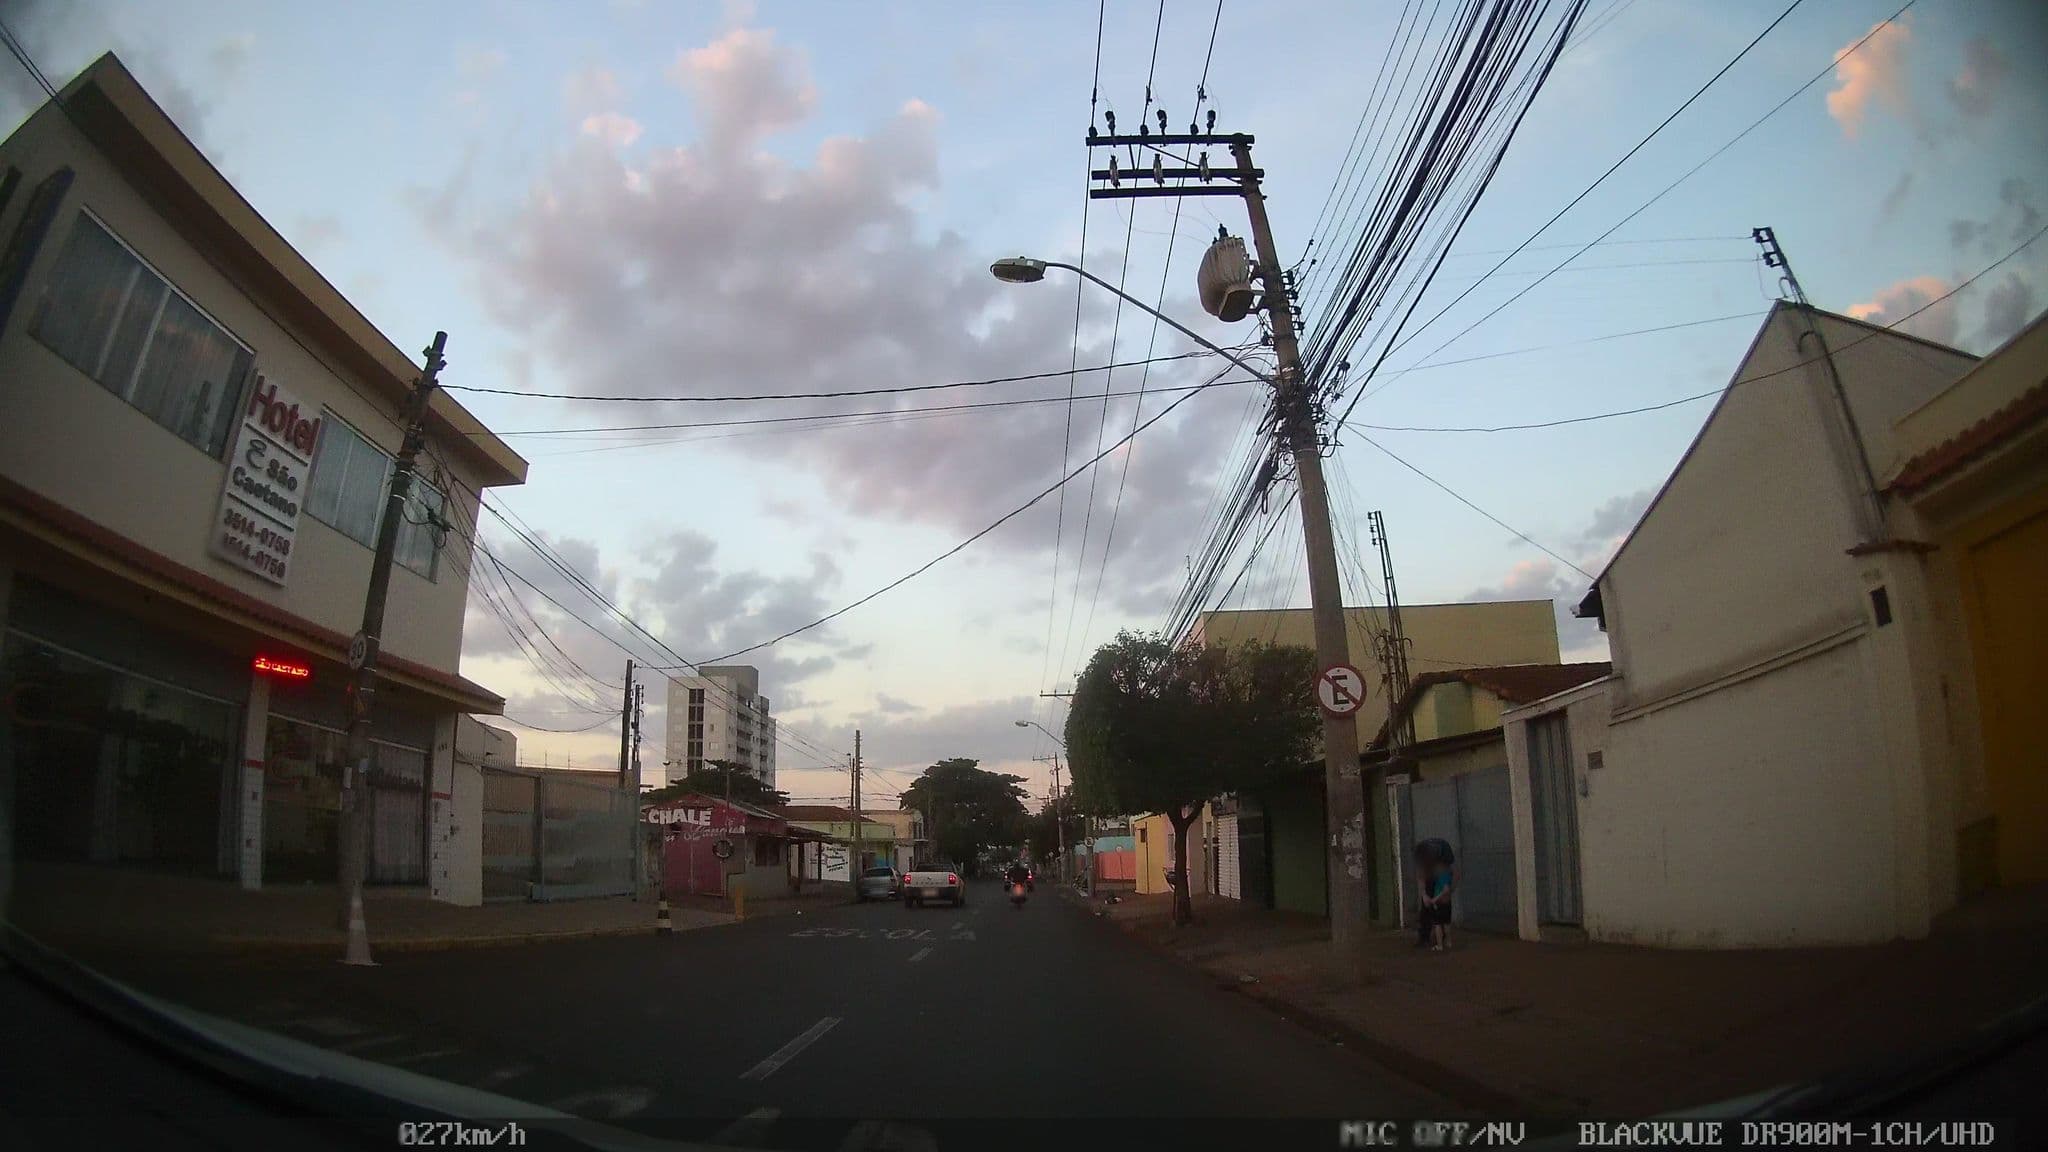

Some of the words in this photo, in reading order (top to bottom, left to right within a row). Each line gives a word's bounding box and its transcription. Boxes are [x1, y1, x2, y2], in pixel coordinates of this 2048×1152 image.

[248, 375, 321, 456] Hotel
[232, 466, 297, 517] Caetano
[267, 458, 298, 491] São
[1331, 675, 1349, 705] E
